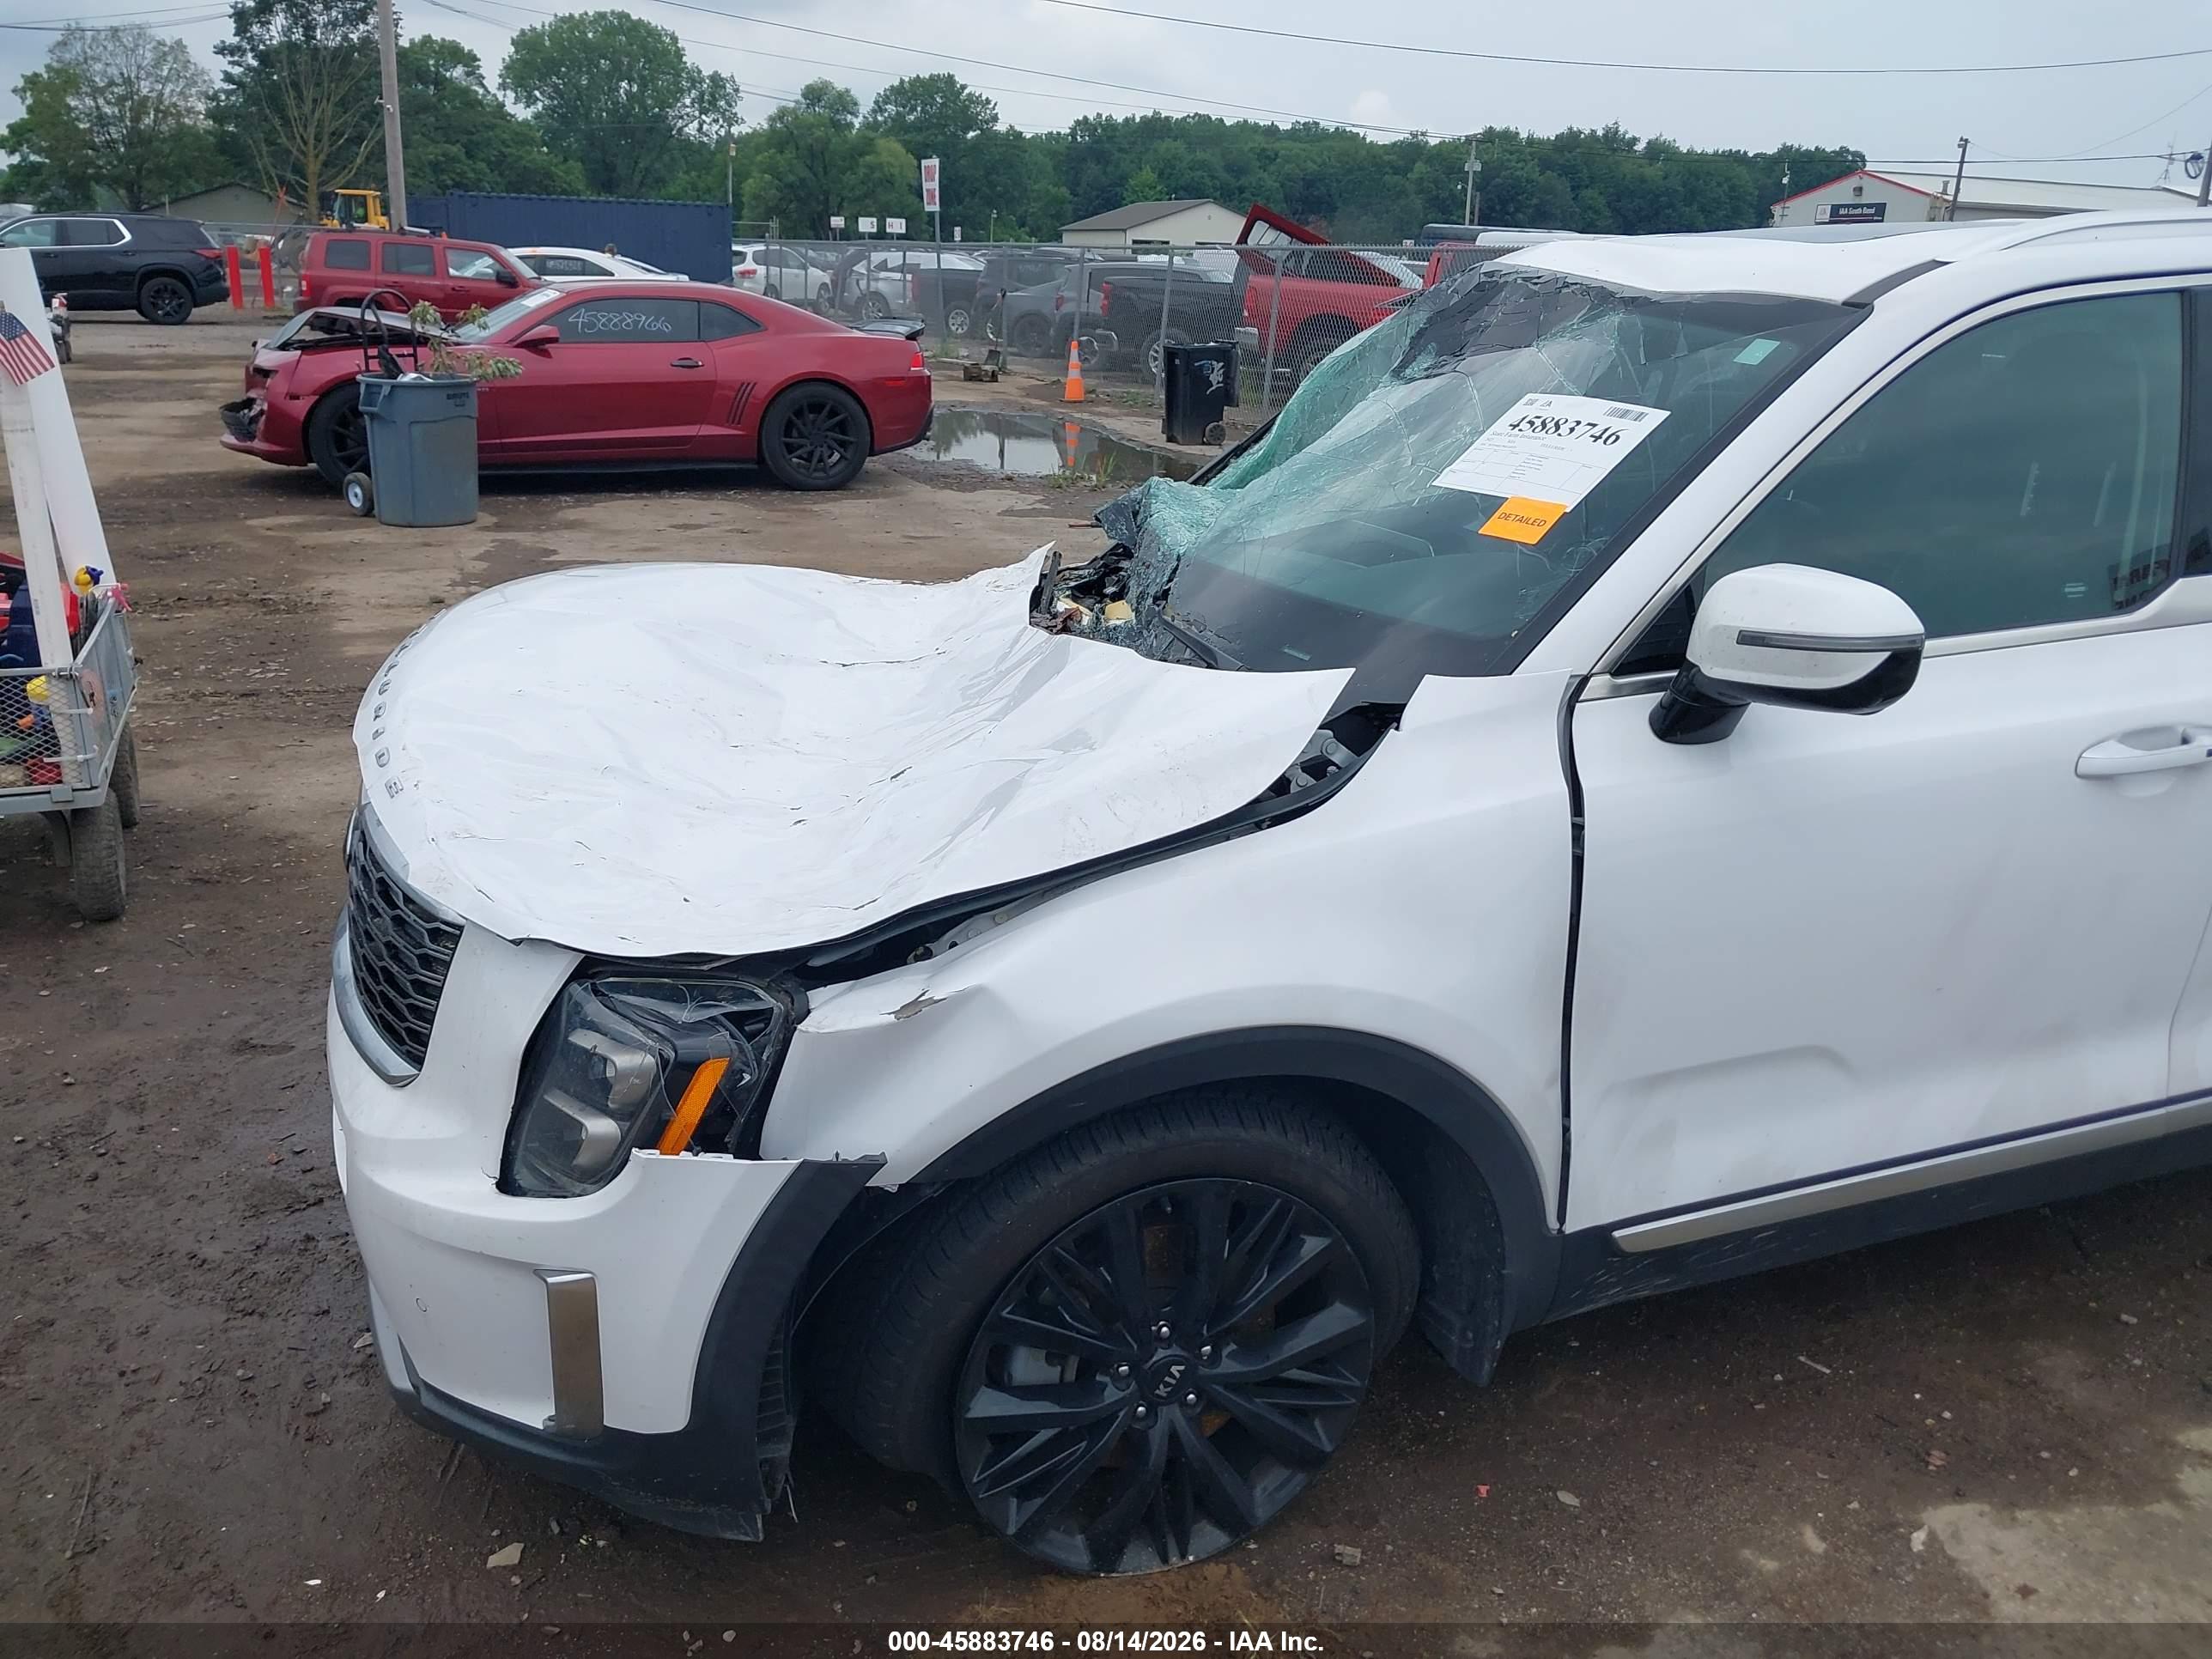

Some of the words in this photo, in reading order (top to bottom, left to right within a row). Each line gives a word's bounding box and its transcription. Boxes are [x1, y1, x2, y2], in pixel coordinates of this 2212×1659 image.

[568, 307, 672, 333] 45888966
[1508, 414, 1629, 447] 45883746
[1497, 512, 1547, 528] DETAILED
[1154, 1365, 1186, 1397] KIA
